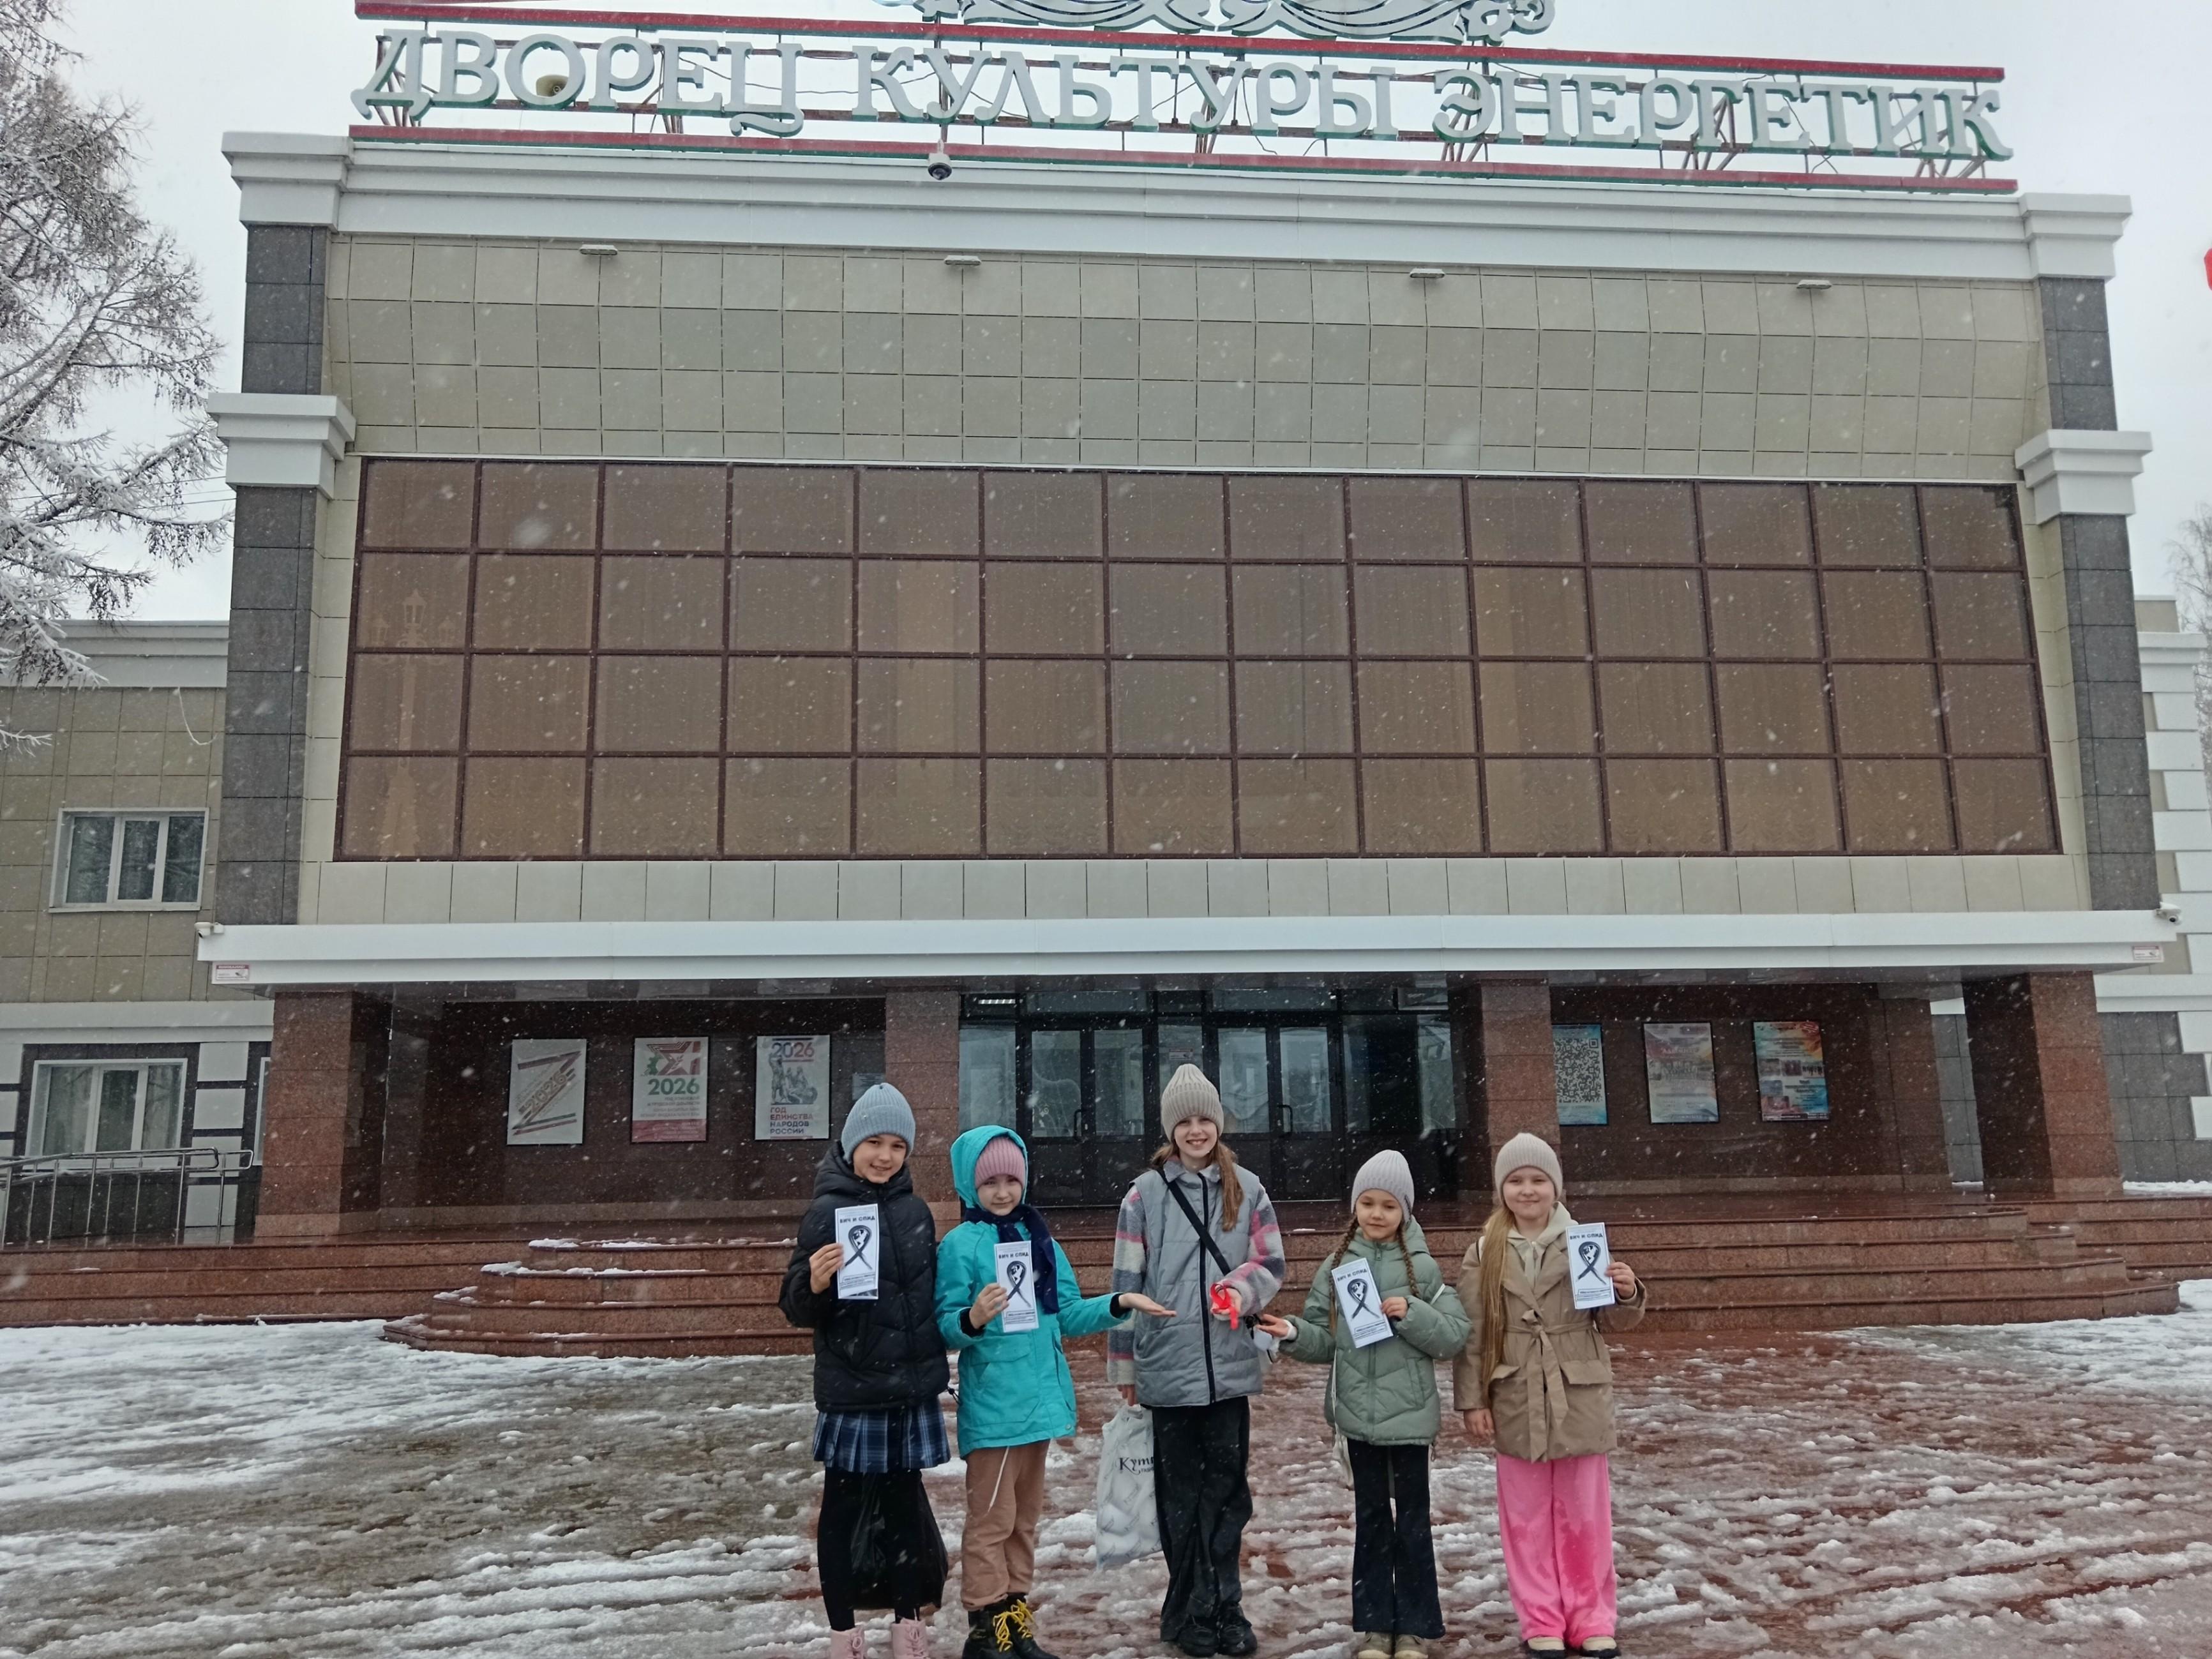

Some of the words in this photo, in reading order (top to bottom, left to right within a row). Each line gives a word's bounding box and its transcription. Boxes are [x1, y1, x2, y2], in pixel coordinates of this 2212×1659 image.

[350, 29, 806, 137] ДВОРЕЦ
[852, 45, 1400, 141] КУЛЬТУРЫ
[1433, 66, 2015, 161] ЭНЕРГЕТИК
[772, 1042, 815, 1058] 2026
[524, 1070, 567, 1113] 2026
[648, 1077, 700, 1095] 2026
[1337, 1274, 1347, 1282] ВИЧ
[1352, 1268, 1368, 1276] СПИД
